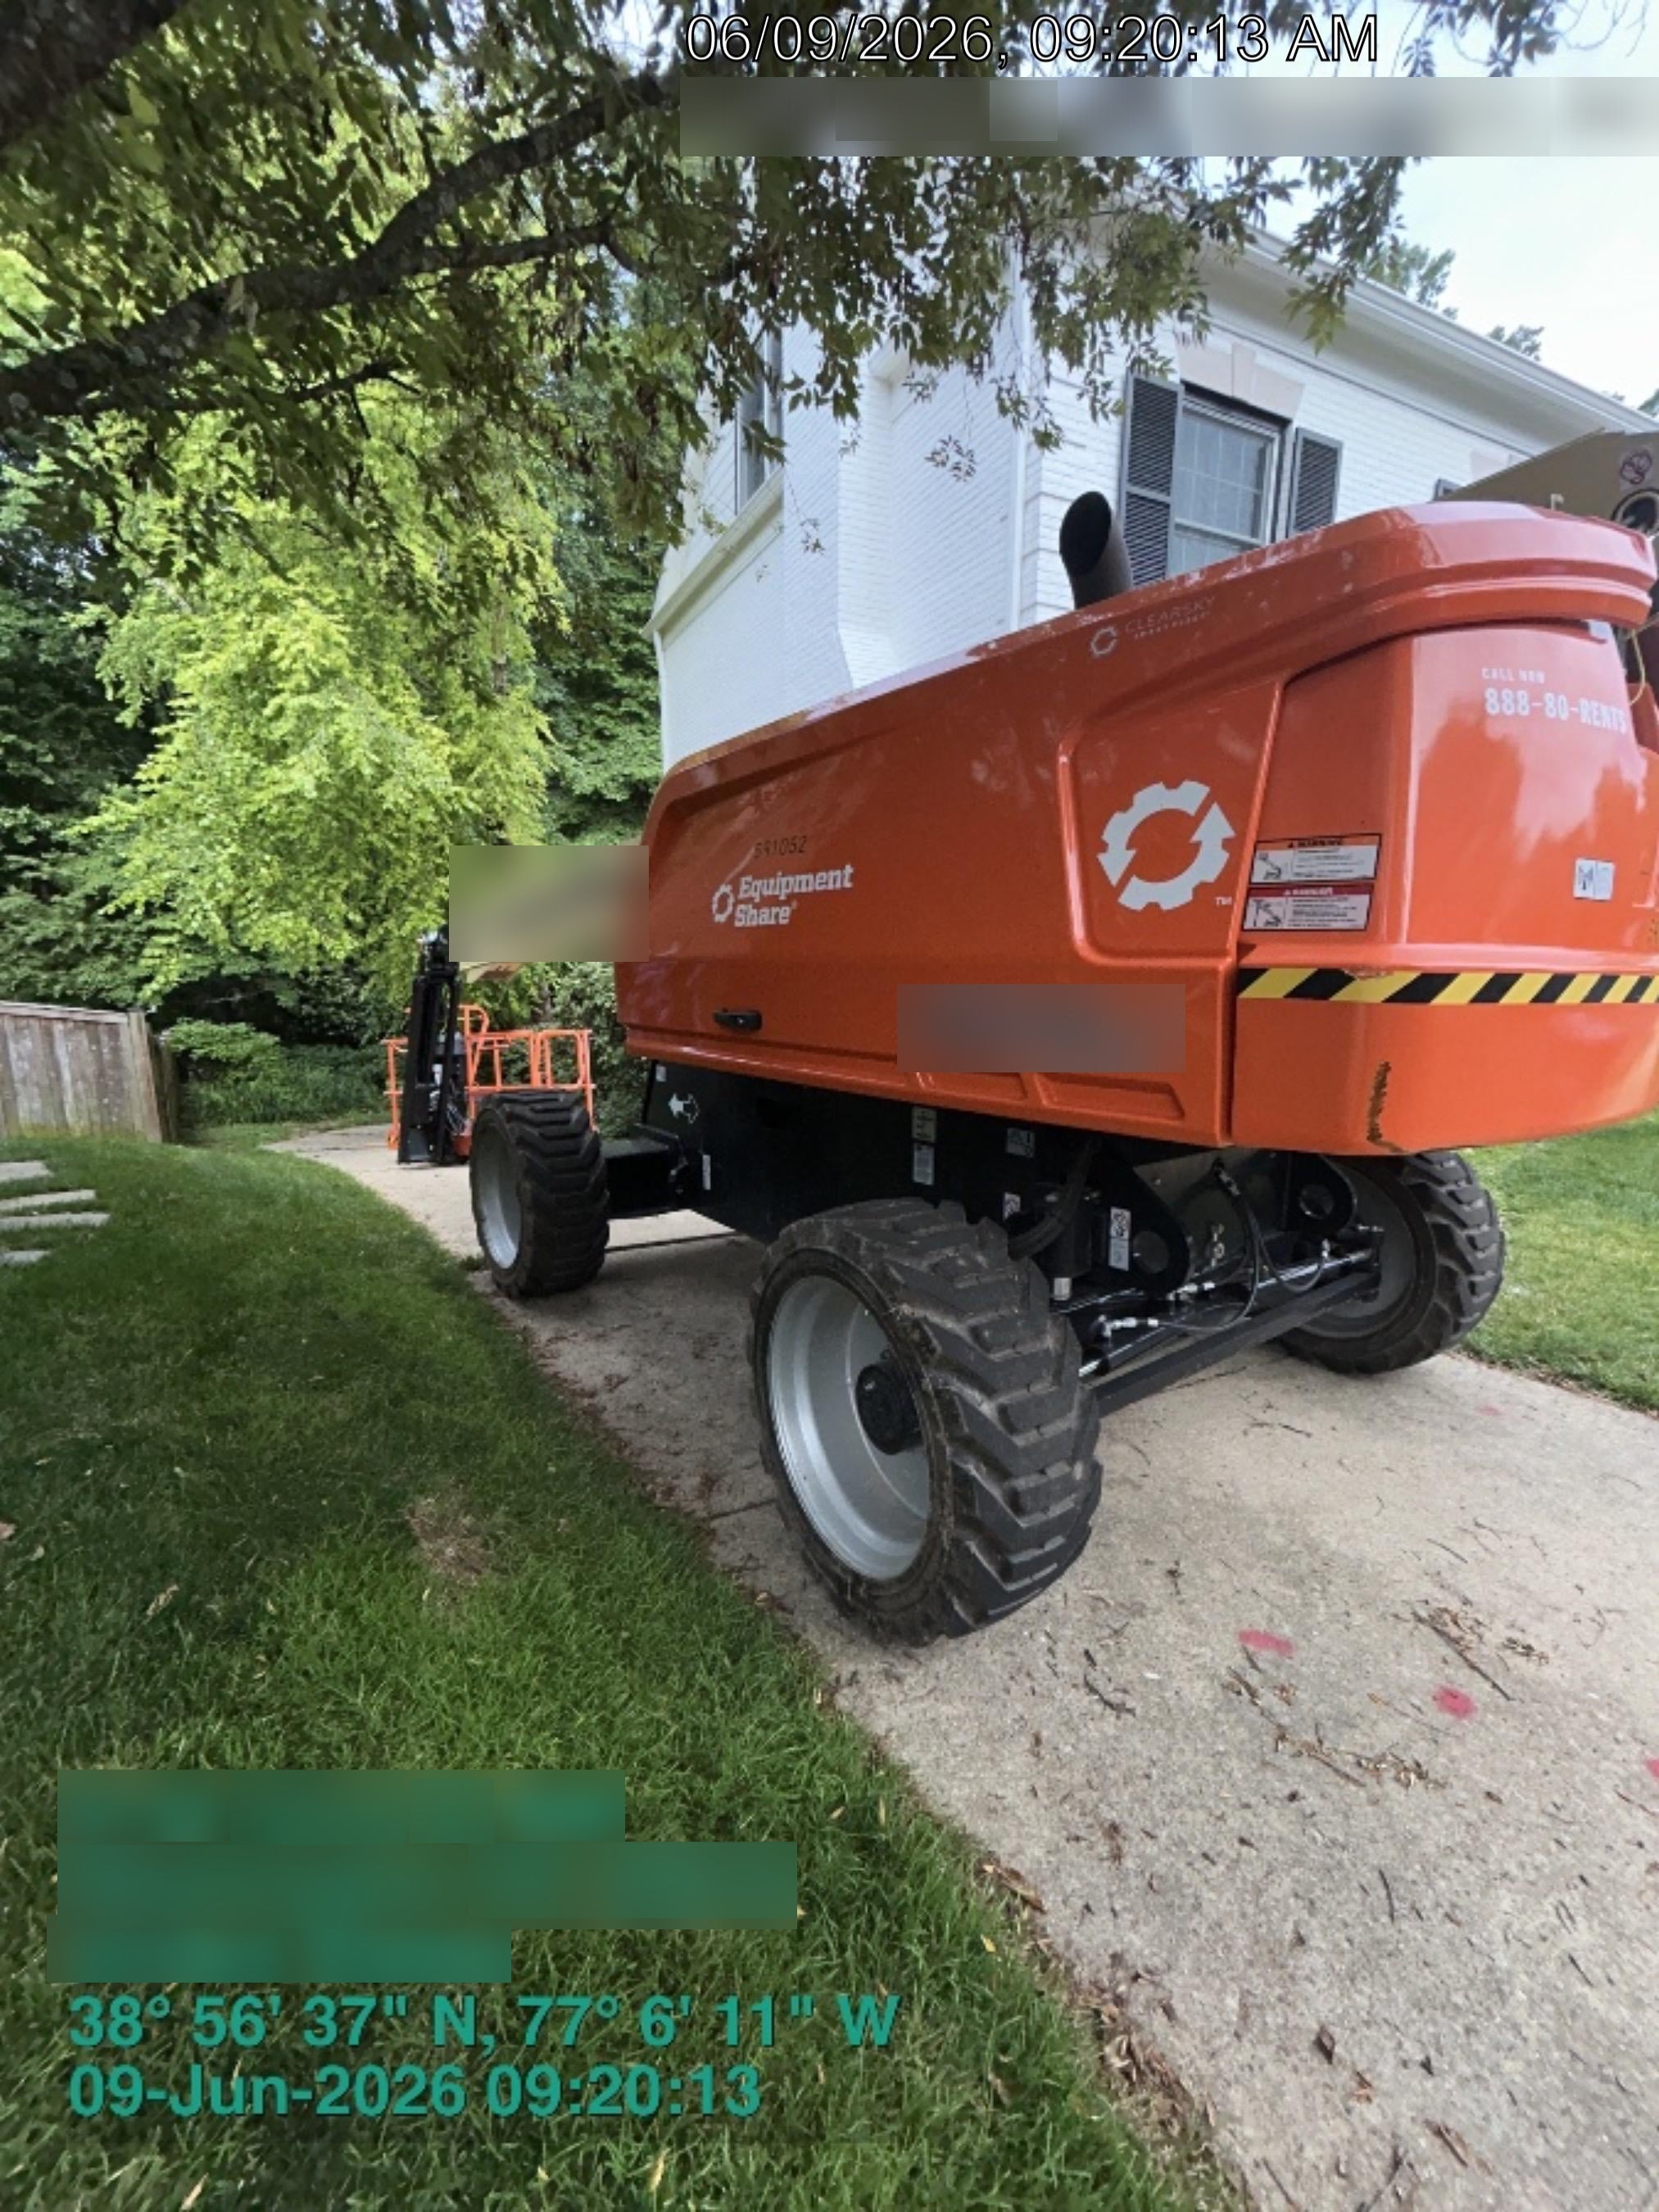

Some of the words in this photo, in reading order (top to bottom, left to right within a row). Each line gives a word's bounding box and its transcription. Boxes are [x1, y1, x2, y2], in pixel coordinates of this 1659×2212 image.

[1481, 667, 1515, 682] CALL
[738, 863, 854, 903] Equipment
[734, 903, 791, 927] Share
